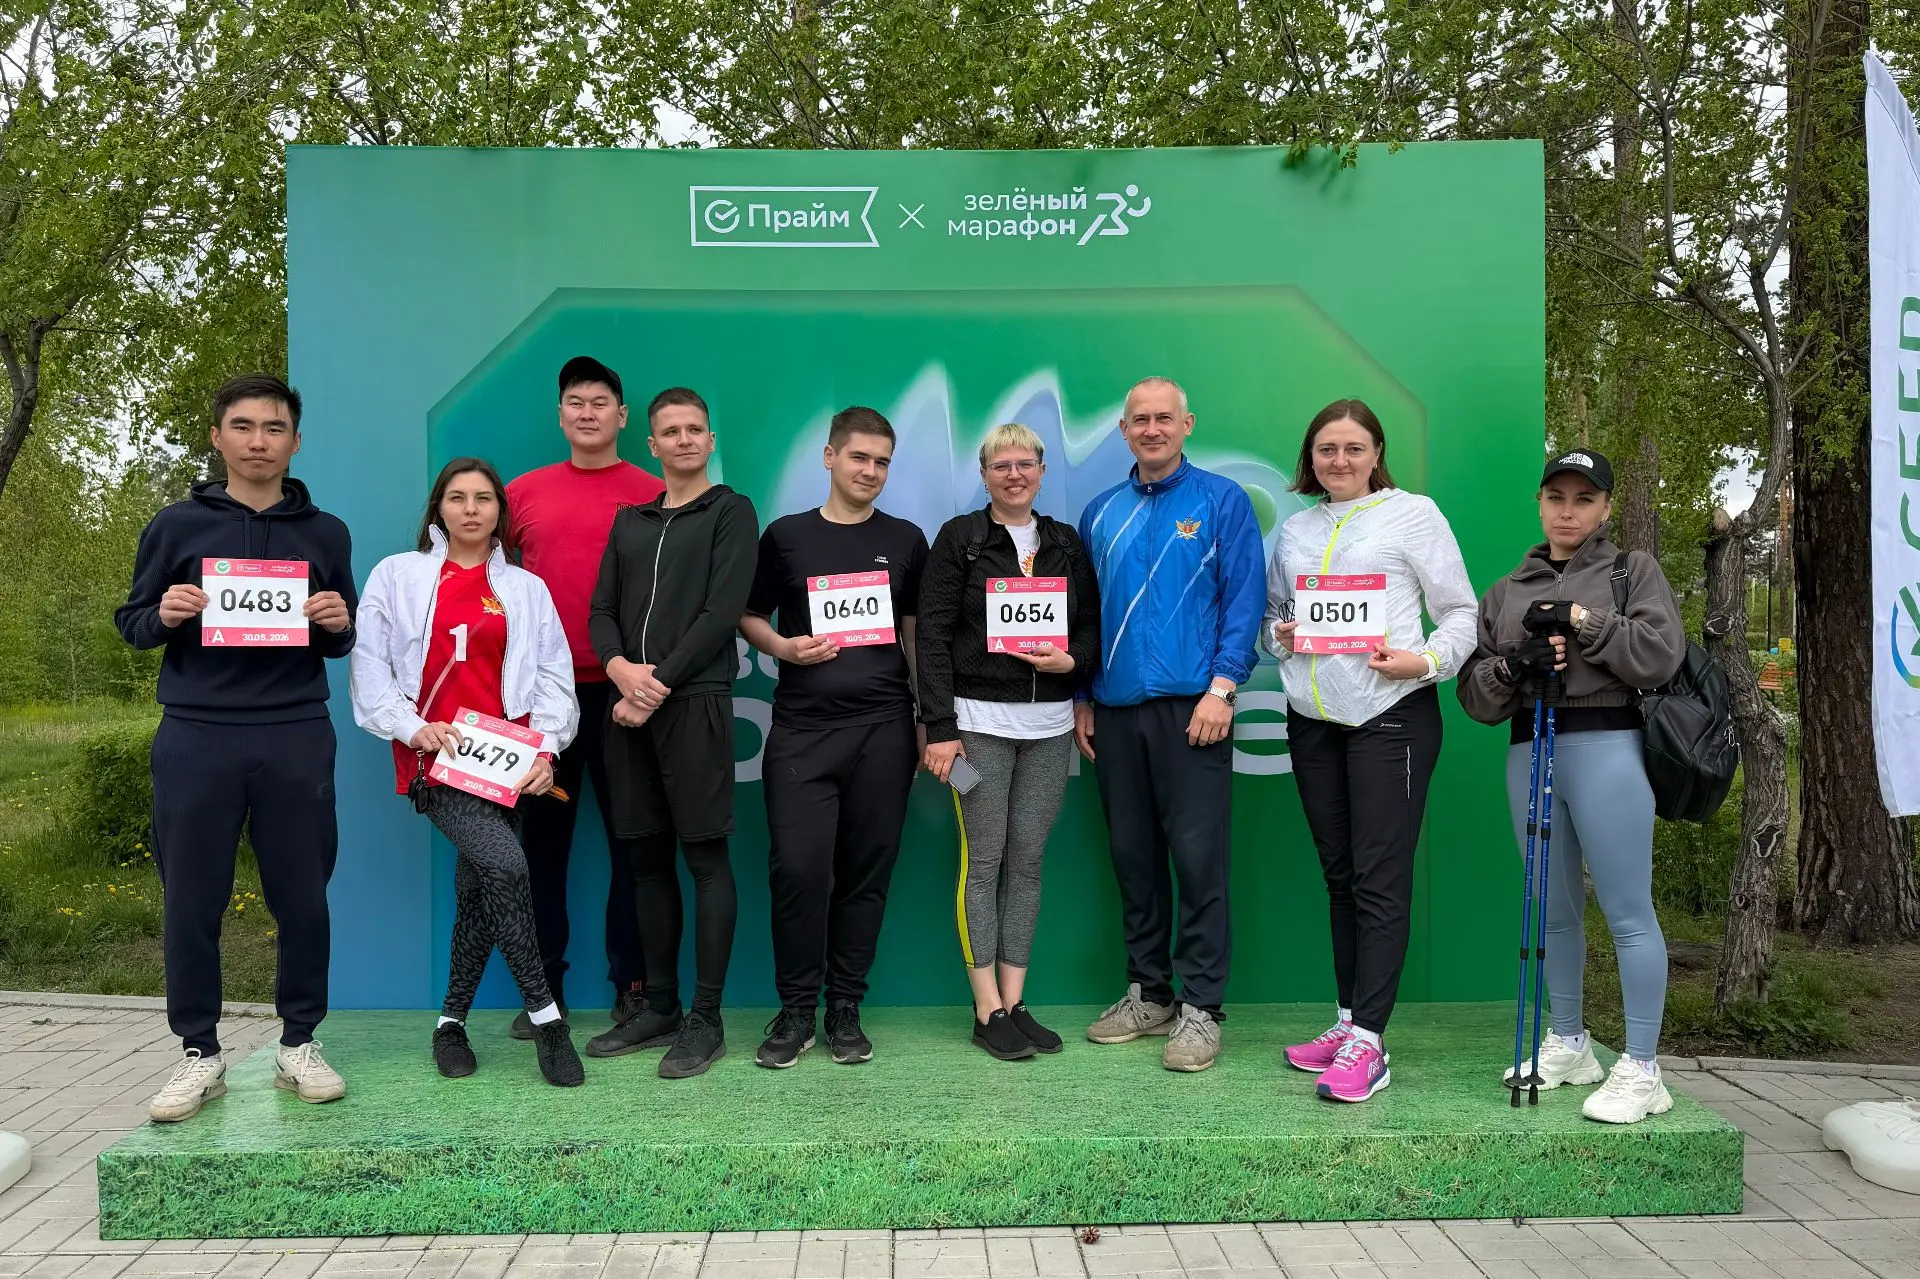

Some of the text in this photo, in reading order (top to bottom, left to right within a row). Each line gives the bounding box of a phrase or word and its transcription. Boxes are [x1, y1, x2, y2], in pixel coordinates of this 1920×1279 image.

[964, 186, 1087, 211] зелёный
[749, 202, 850, 233] Прайм
[948, 212, 1076, 240] марафон
[220, 588, 292, 613] 0483
[823, 596, 879, 620] 0640
[1000, 603, 1055, 623] 0654
[1310, 601, 1368, 623] 0501
[449, 623, 468, 662] 1
[457, 736, 520, 772] 0479
